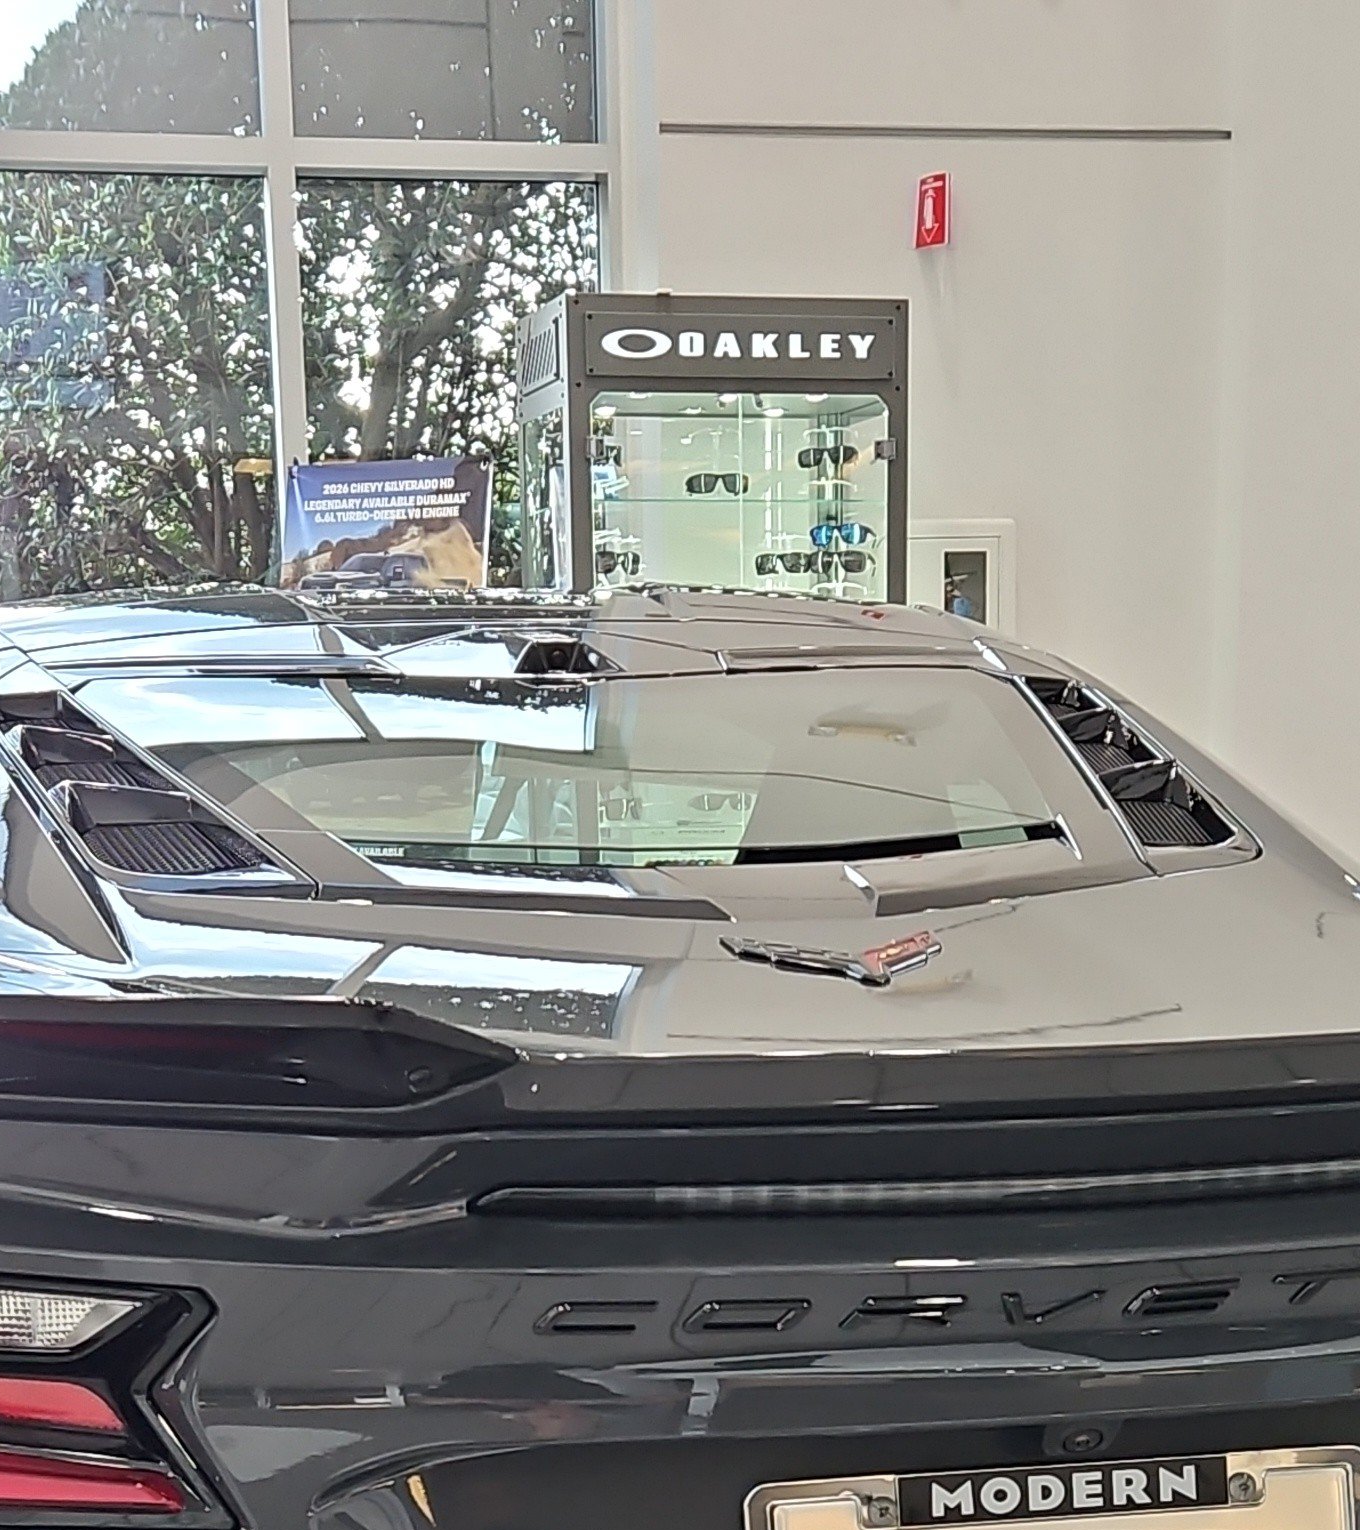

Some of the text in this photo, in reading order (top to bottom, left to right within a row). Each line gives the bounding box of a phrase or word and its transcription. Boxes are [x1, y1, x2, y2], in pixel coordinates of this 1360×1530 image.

[678, 331, 876, 359] OAKLEY
[323, 477, 455, 495] 2026 CHEVY SILVERADO HD
[304, 498, 362, 512] LEGENDARY
[362, 496, 415, 509] AVAILABLE
[337, 509, 407, 522] TURBO-DIESEL
[422, 505, 460, 518] ENGINE
[930, 1464, 1199, 1518] MODERN
